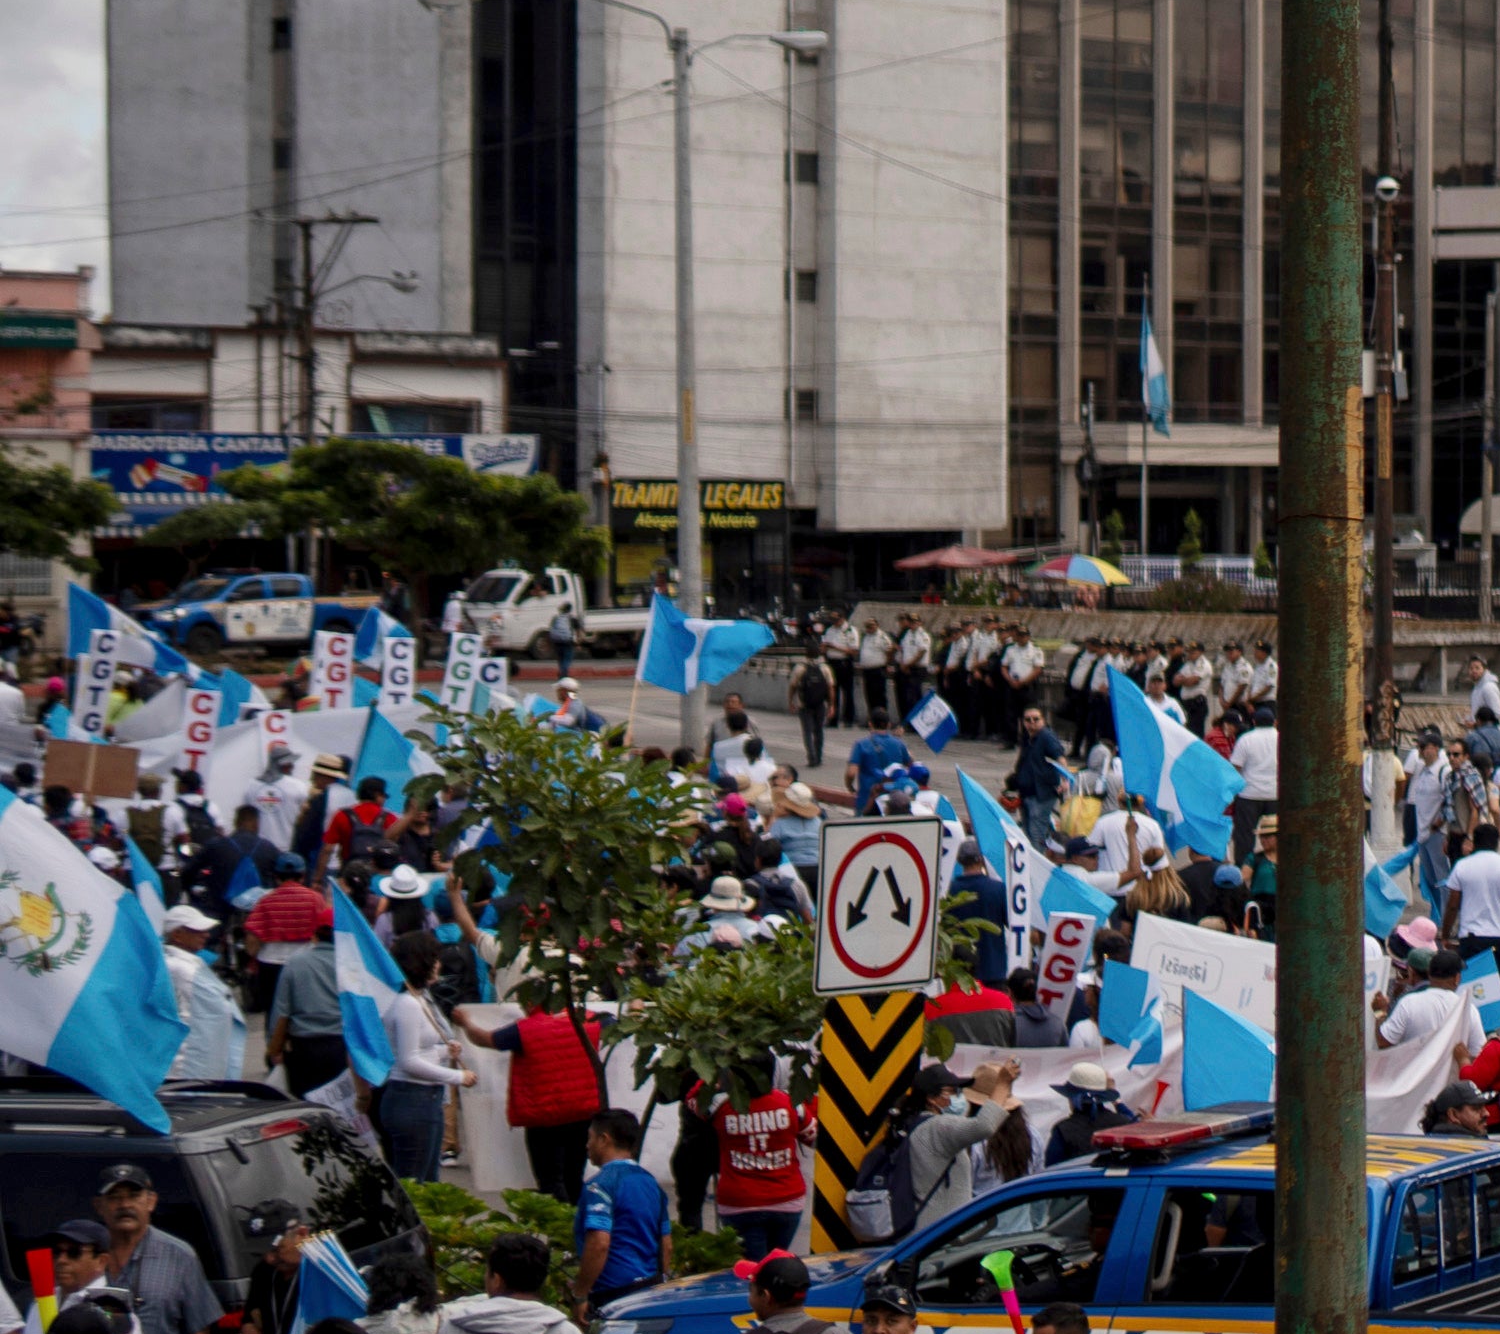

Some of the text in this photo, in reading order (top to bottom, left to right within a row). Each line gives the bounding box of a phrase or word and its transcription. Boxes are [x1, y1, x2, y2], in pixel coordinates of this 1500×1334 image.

[613, 482, 783, 510] TRAMIT LEGALES
[82, 633, 116, 732] CGTG
[326, 636, 348, 708] CGT
[388, 640, 410, 705] CGT
[446, 637, 474, 705] CGT
[183, 692, 214, 772] CGT
[1011, 842, 1028, 958] CGT
[1038, 918, 1085, 1006] CGT
[725, 1108, 791, 1135] BRING
[748, 1133, 771, 1153] IT
